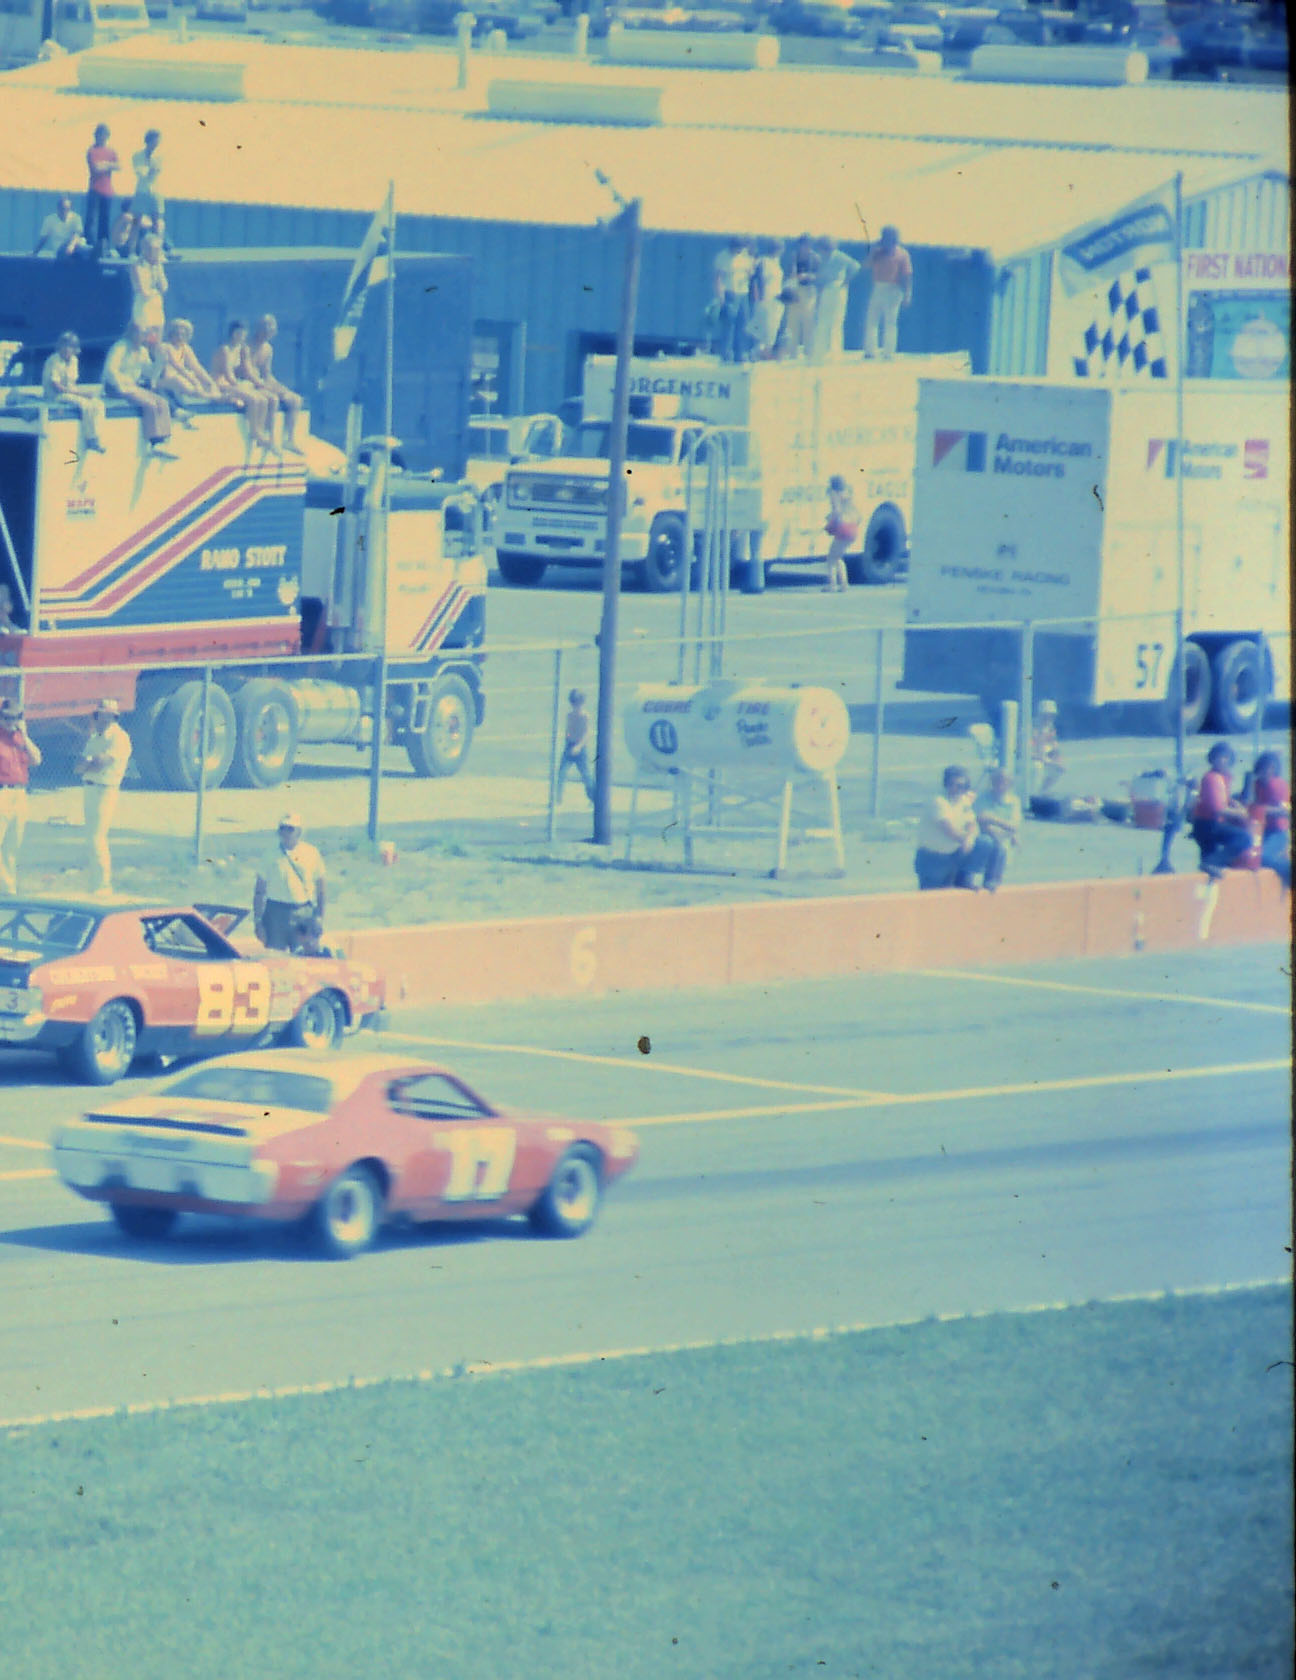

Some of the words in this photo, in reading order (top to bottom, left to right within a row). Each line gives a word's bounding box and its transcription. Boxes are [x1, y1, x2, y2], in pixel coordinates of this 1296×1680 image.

[1188, 253, 1230, 279] FIRST
[996, 433, 1093, 457] American
[993, 455, 1066, 478] Motors
[1136, 643, 1163, 689] 57
[570, 926, 598, 984] 6
[197, 963, 271, 1035] 83
